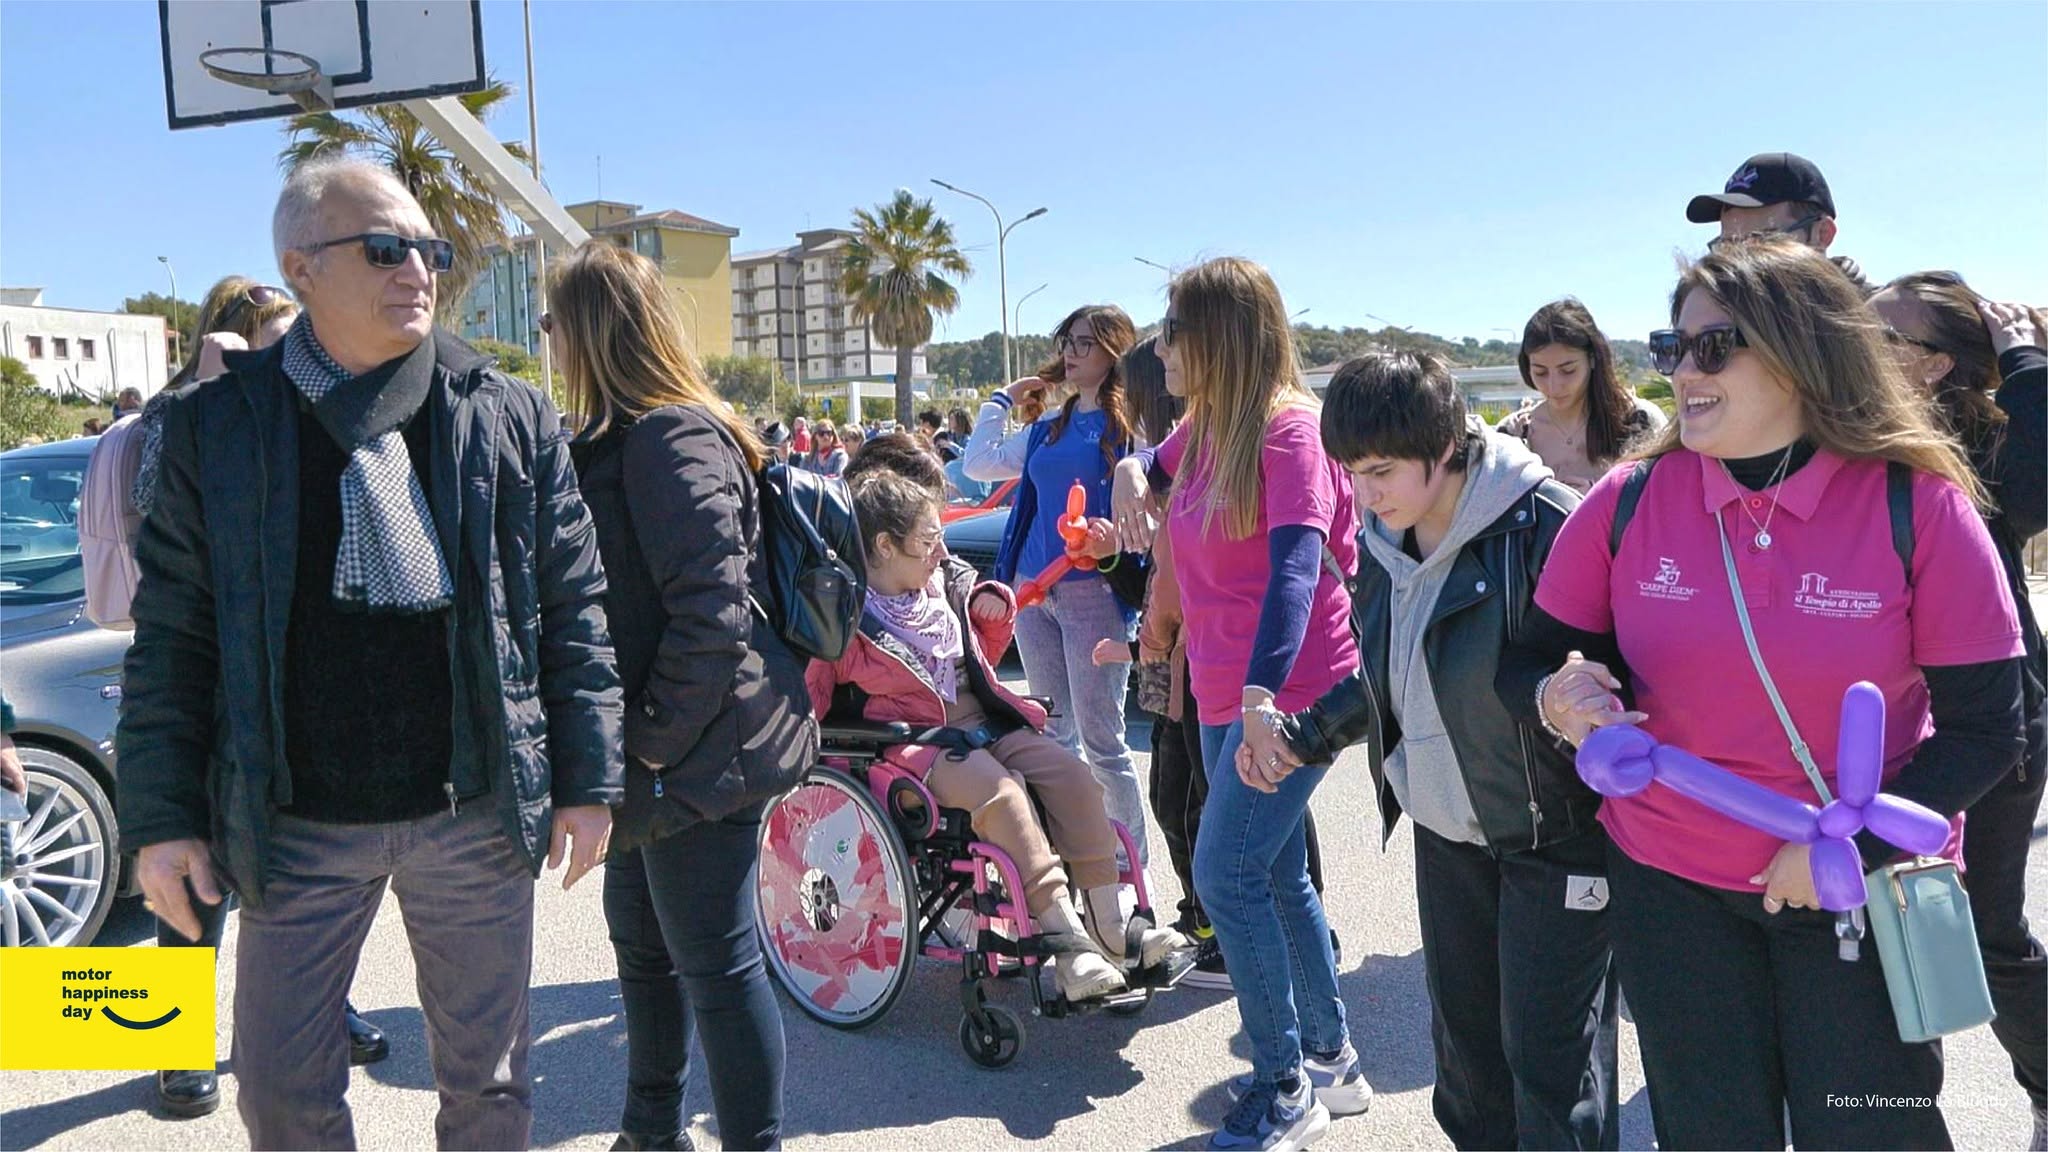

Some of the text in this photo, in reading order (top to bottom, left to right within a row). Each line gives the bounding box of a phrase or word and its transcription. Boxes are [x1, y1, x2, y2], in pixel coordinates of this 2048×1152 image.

[1804, 595, 1837, 608] Tempio
[1838, 599, 1849, 608] di
[1849, 599, 1882, 610] Apollo
